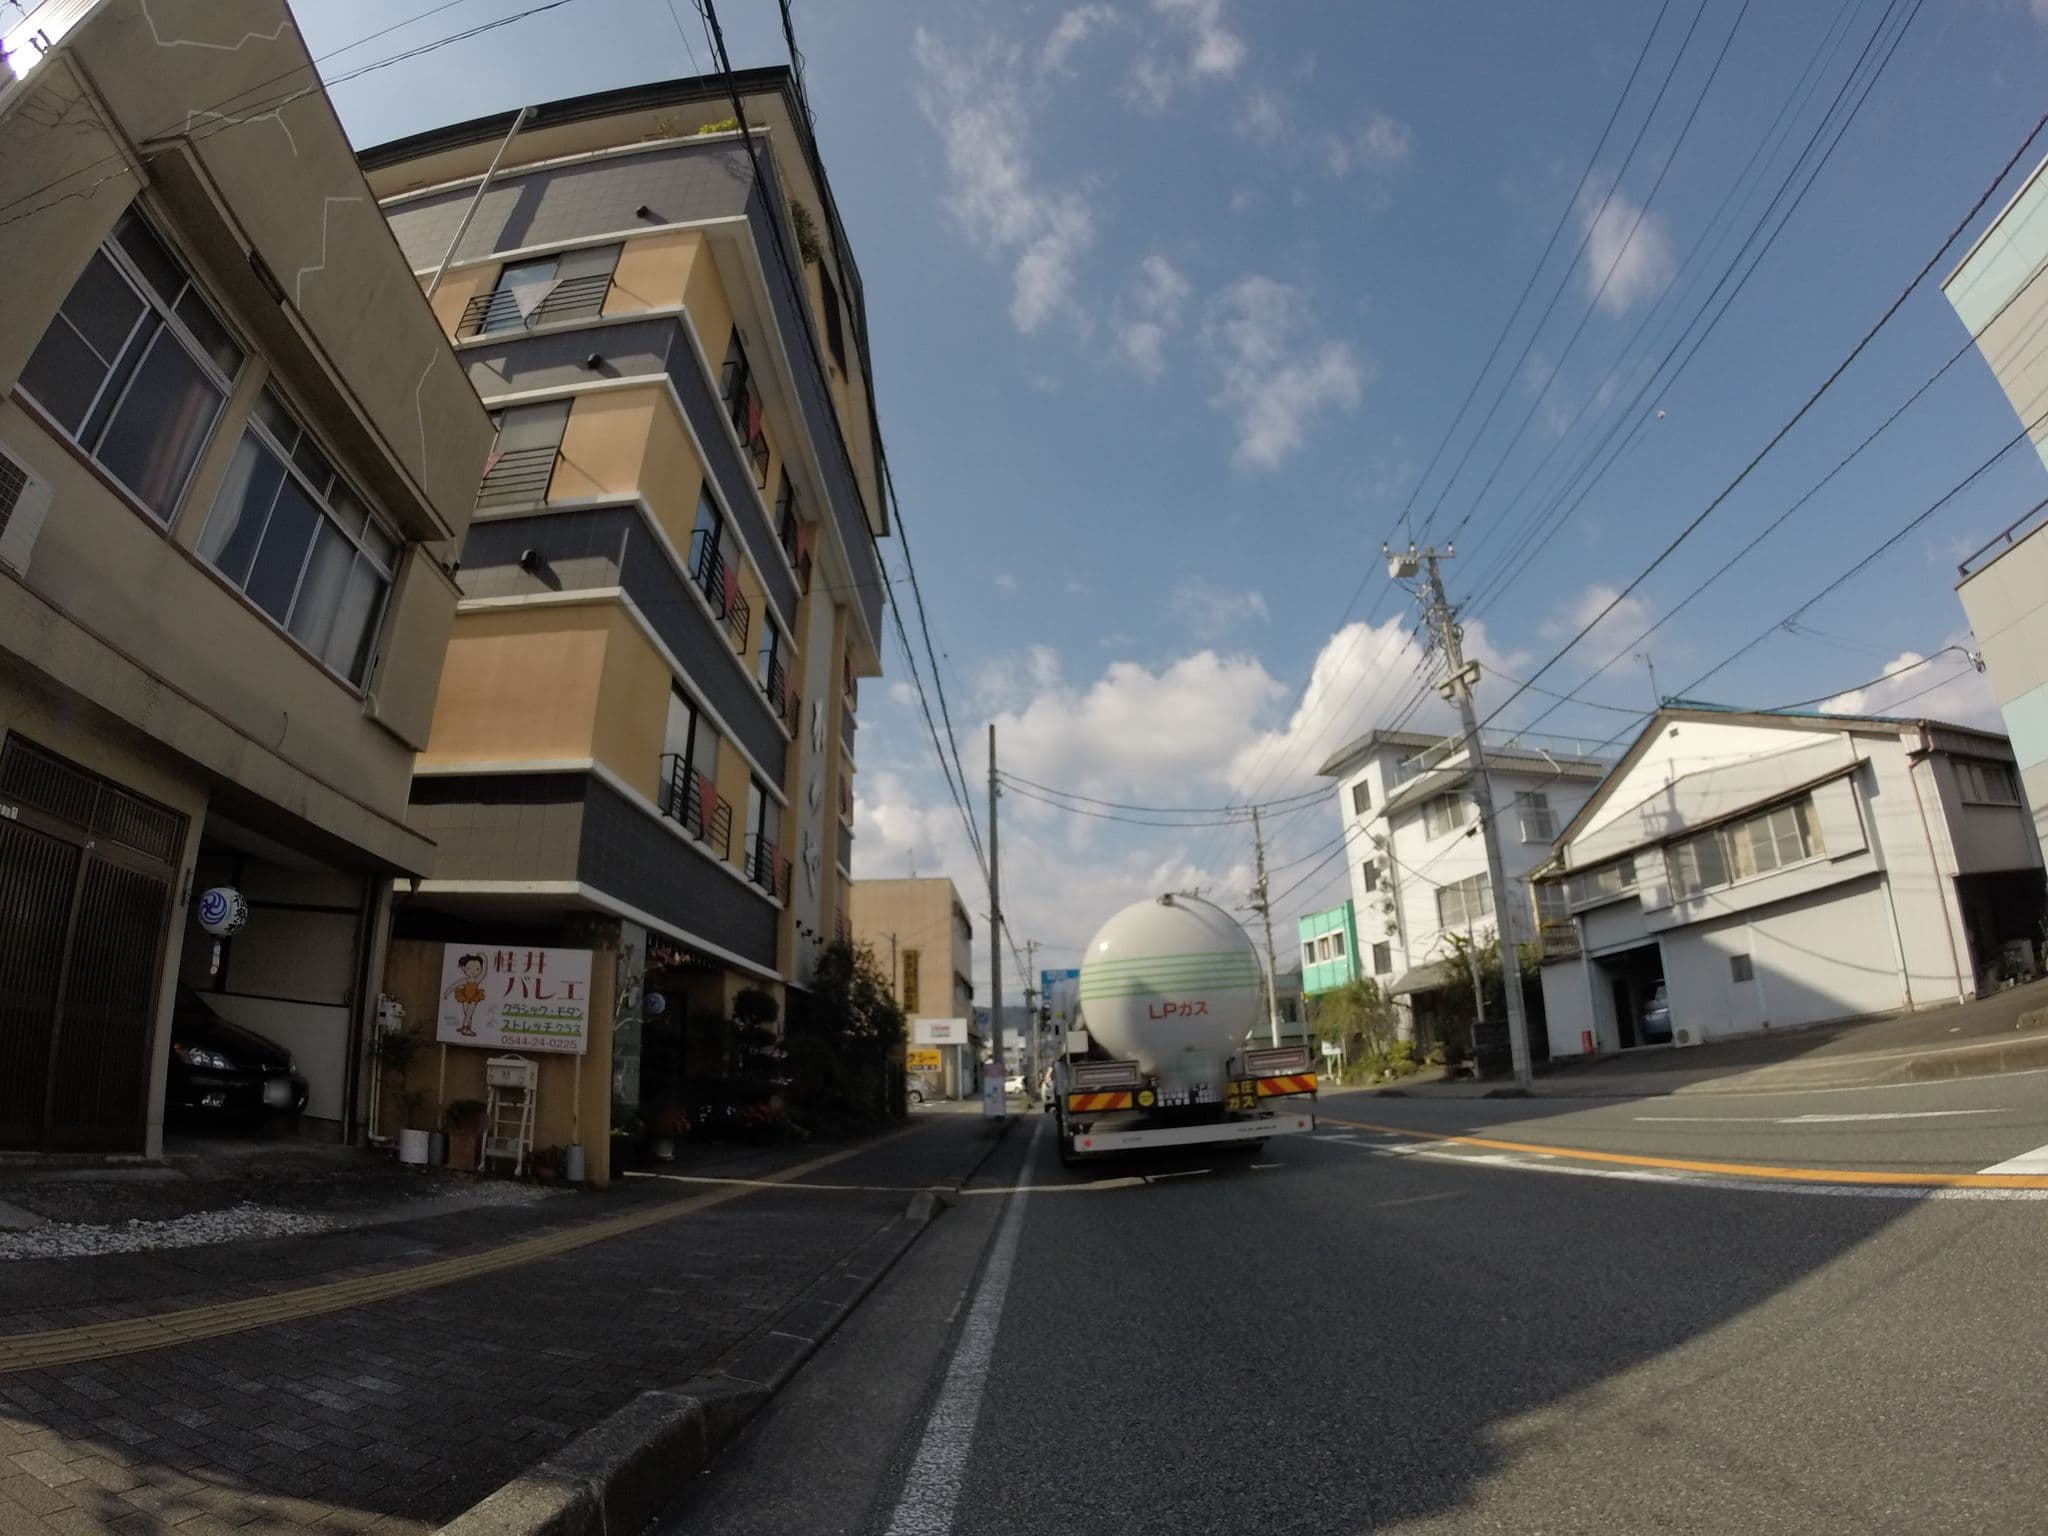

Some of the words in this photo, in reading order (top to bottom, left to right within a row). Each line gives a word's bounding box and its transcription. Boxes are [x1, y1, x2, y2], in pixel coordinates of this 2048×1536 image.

[494, 950, 551, 974] 桂井
[504, 976, 584, 1001] バレエ
[1149, 1000, 1208, 1020] LPガス
